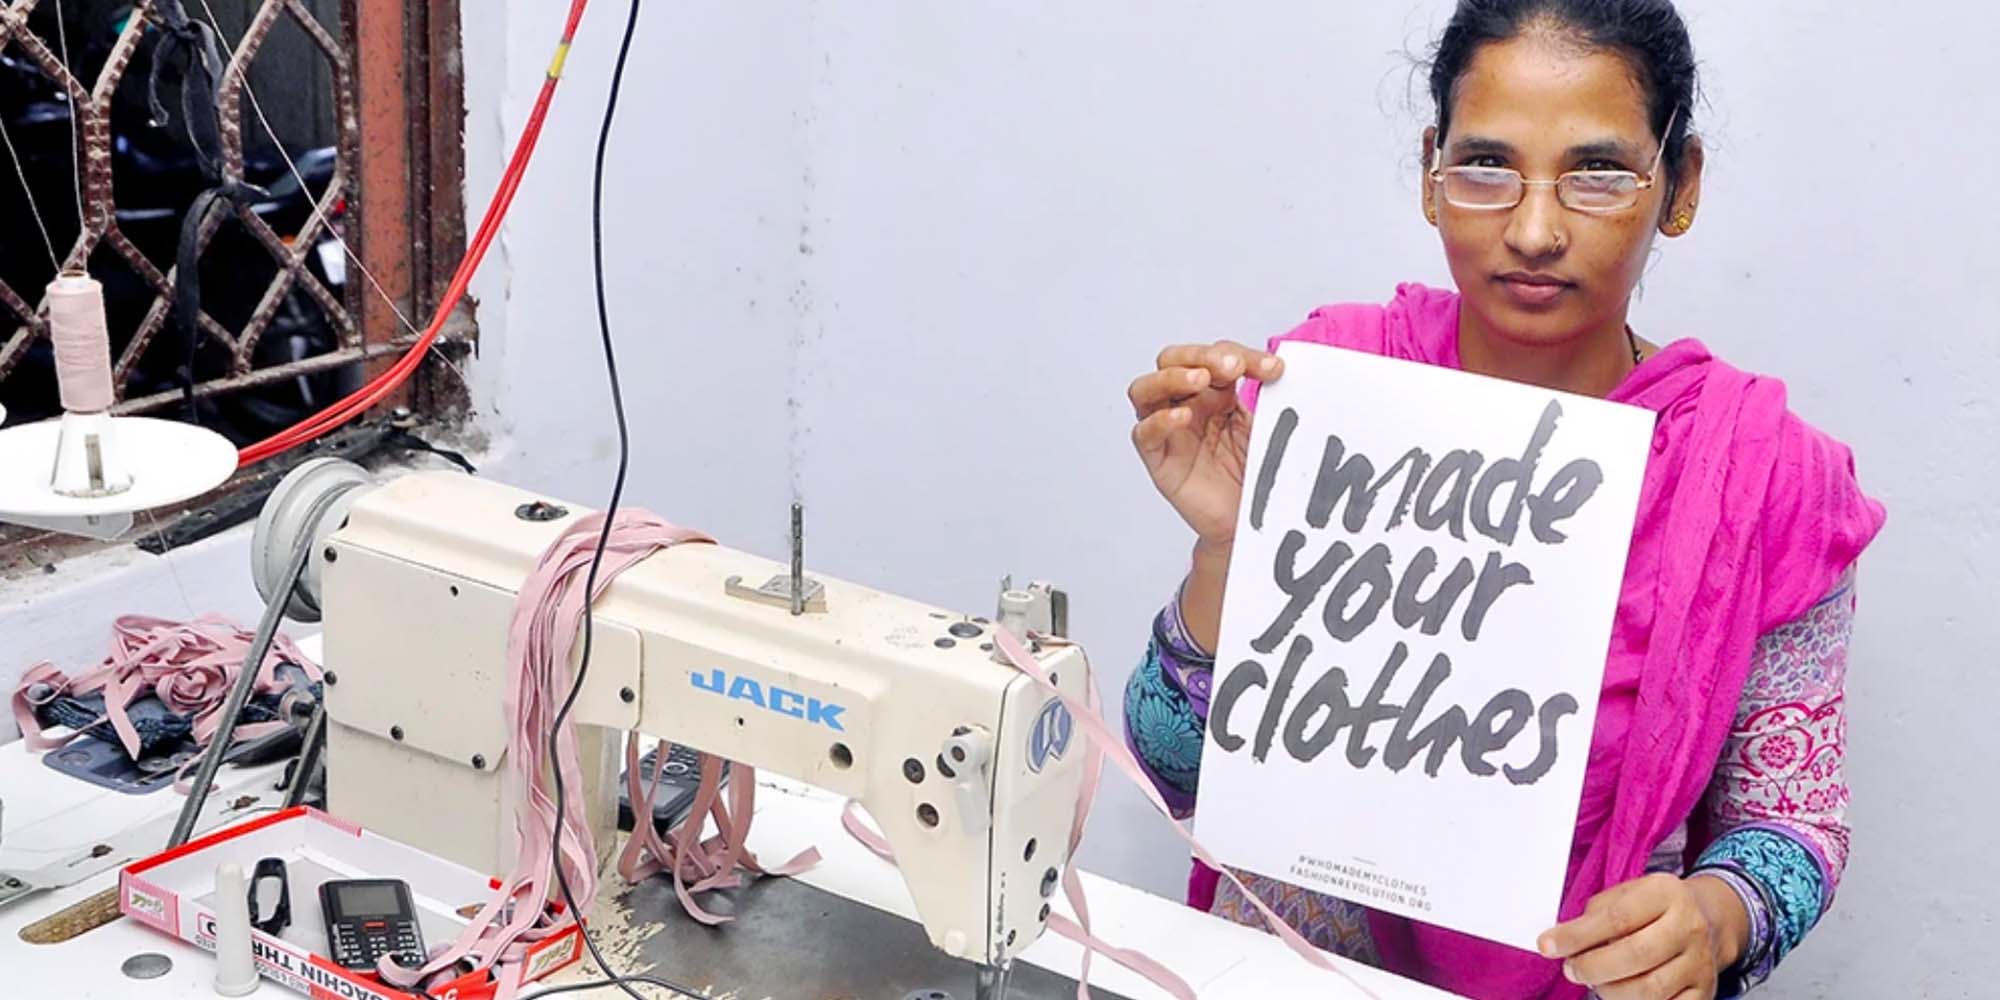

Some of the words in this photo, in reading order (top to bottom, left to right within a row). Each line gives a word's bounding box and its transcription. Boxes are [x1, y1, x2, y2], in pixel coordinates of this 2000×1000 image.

[1249, 407, 1299, 531] I
[1305, 398, 1603, 546] made
[1250, 529, 1534, 654] your
[691, 669, 846, 732] JACK
[1209, 634, 1578, 785] clothes
[1289, 865, 1432, 912] FASHIONREVOLUTION.ORG
[1298, 855, 1427, 896] #WHOMADEMYCLOTHES
